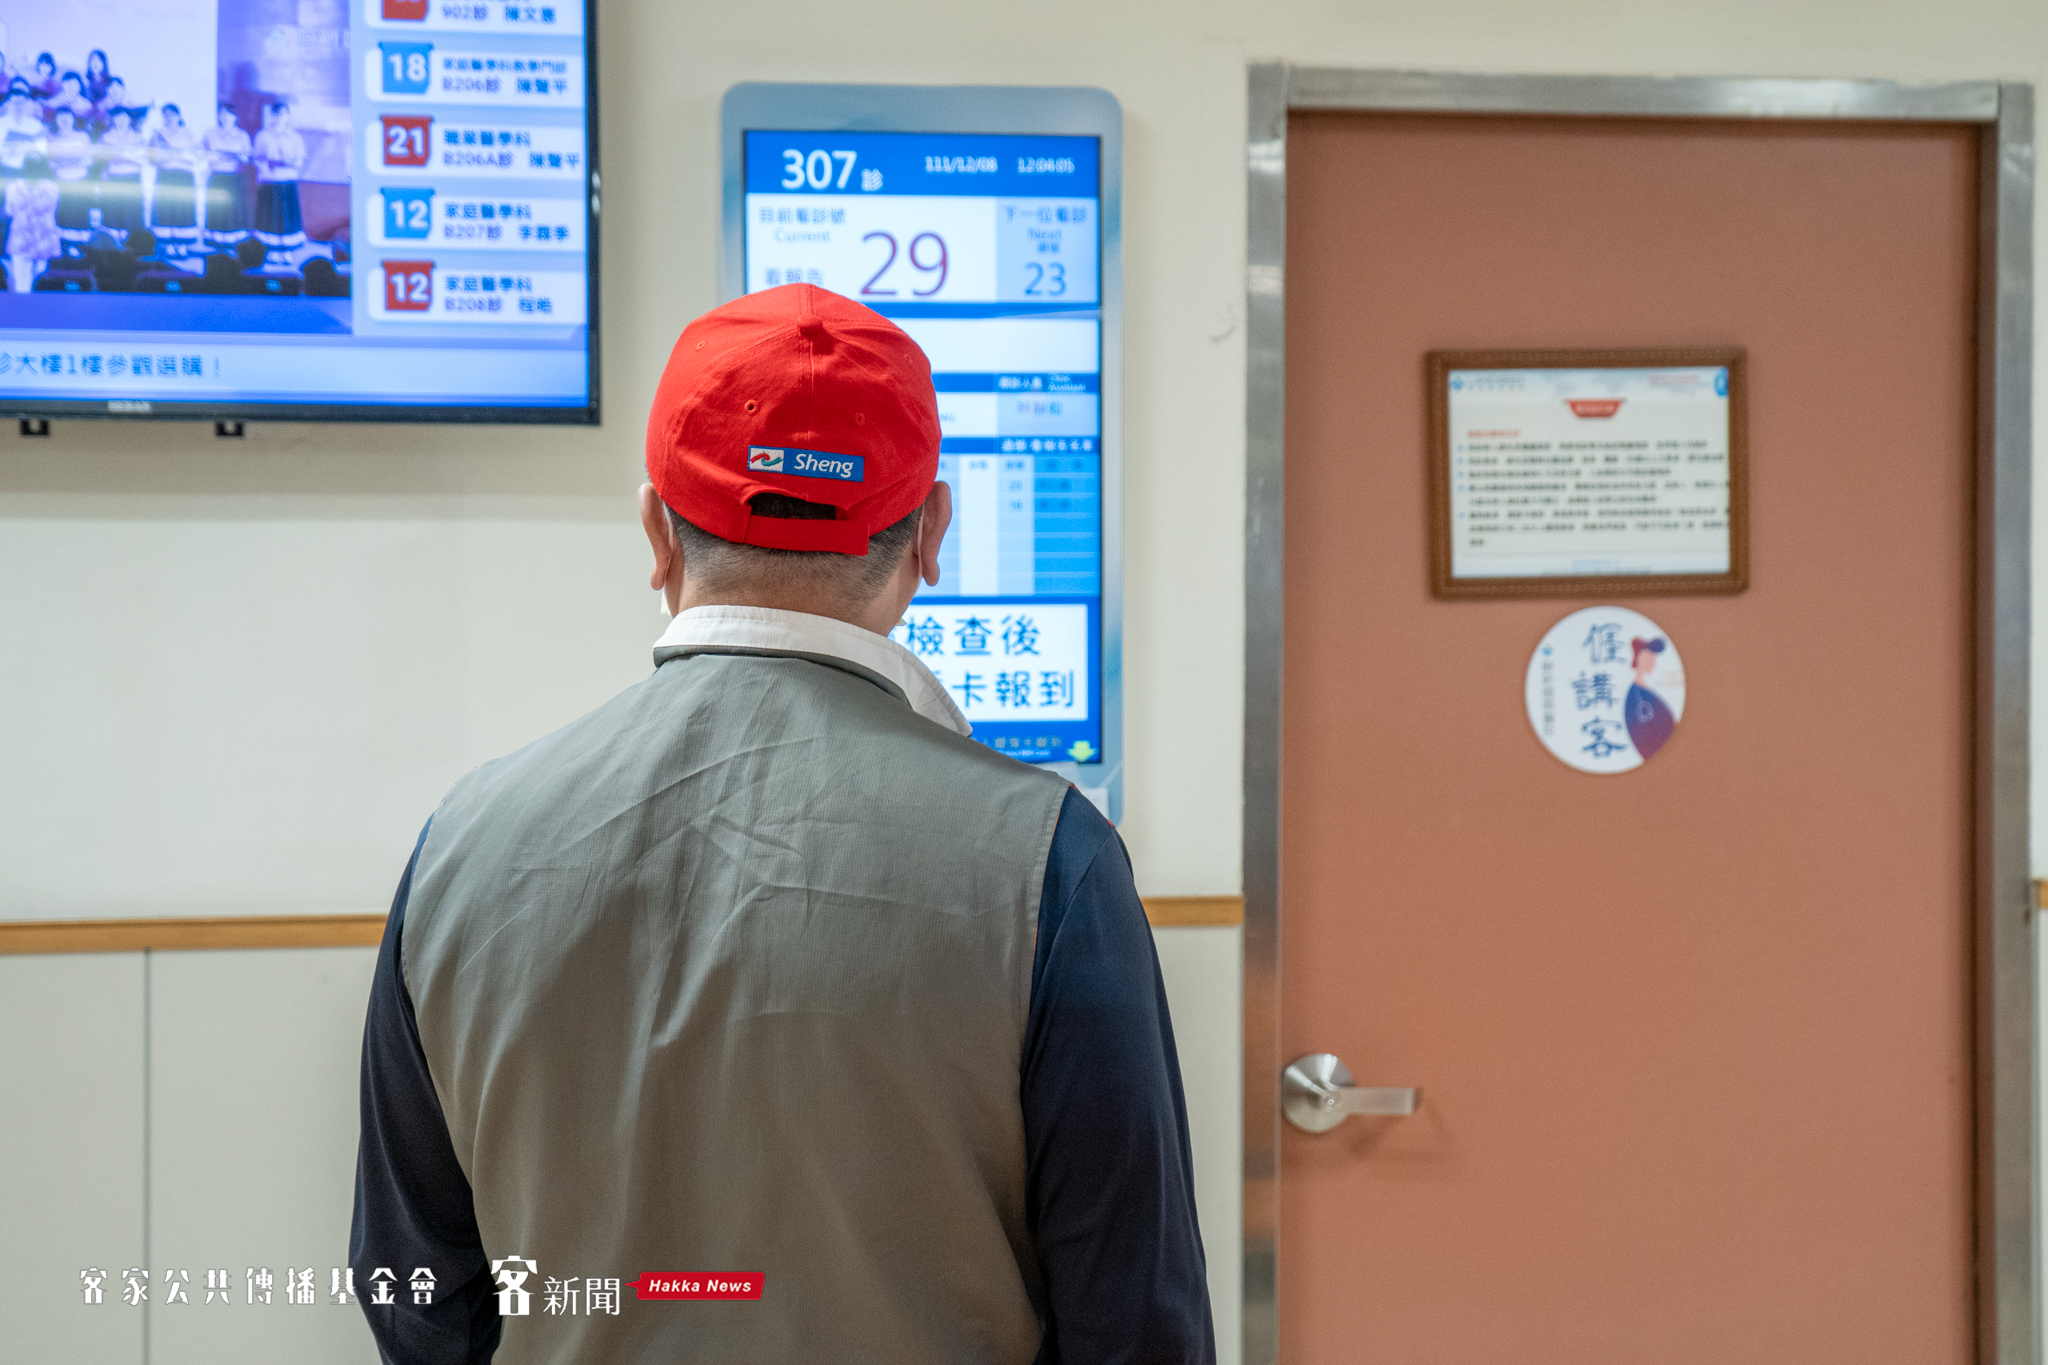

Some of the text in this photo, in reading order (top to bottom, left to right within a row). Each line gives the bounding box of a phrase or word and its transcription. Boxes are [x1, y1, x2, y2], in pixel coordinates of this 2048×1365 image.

[388, 53, 427, 82] 18
[387, 126, 424, 157] 21
[781, 148, 883, 191] 307 診
[389, 199, 429, 230] 12
[444, 202, 532, 220] 家庭醫學科
[759, 206, 846, 225] 目前看診號
[1002, 204, 1089, 223] 下一位看診
[774, 228, 831, 244] Current
[860, 230, 948, 297] 29
[1023, 261, 1068, 297] 23
[389, 272, 430, 303] 12
[444, 276, 533, 294] 家庭醫學科
[794, 453, 854, 478] Sheng
[888, 615, 1041, 657] 檢查後
[932, 669, 1075, 708] 卡報到
